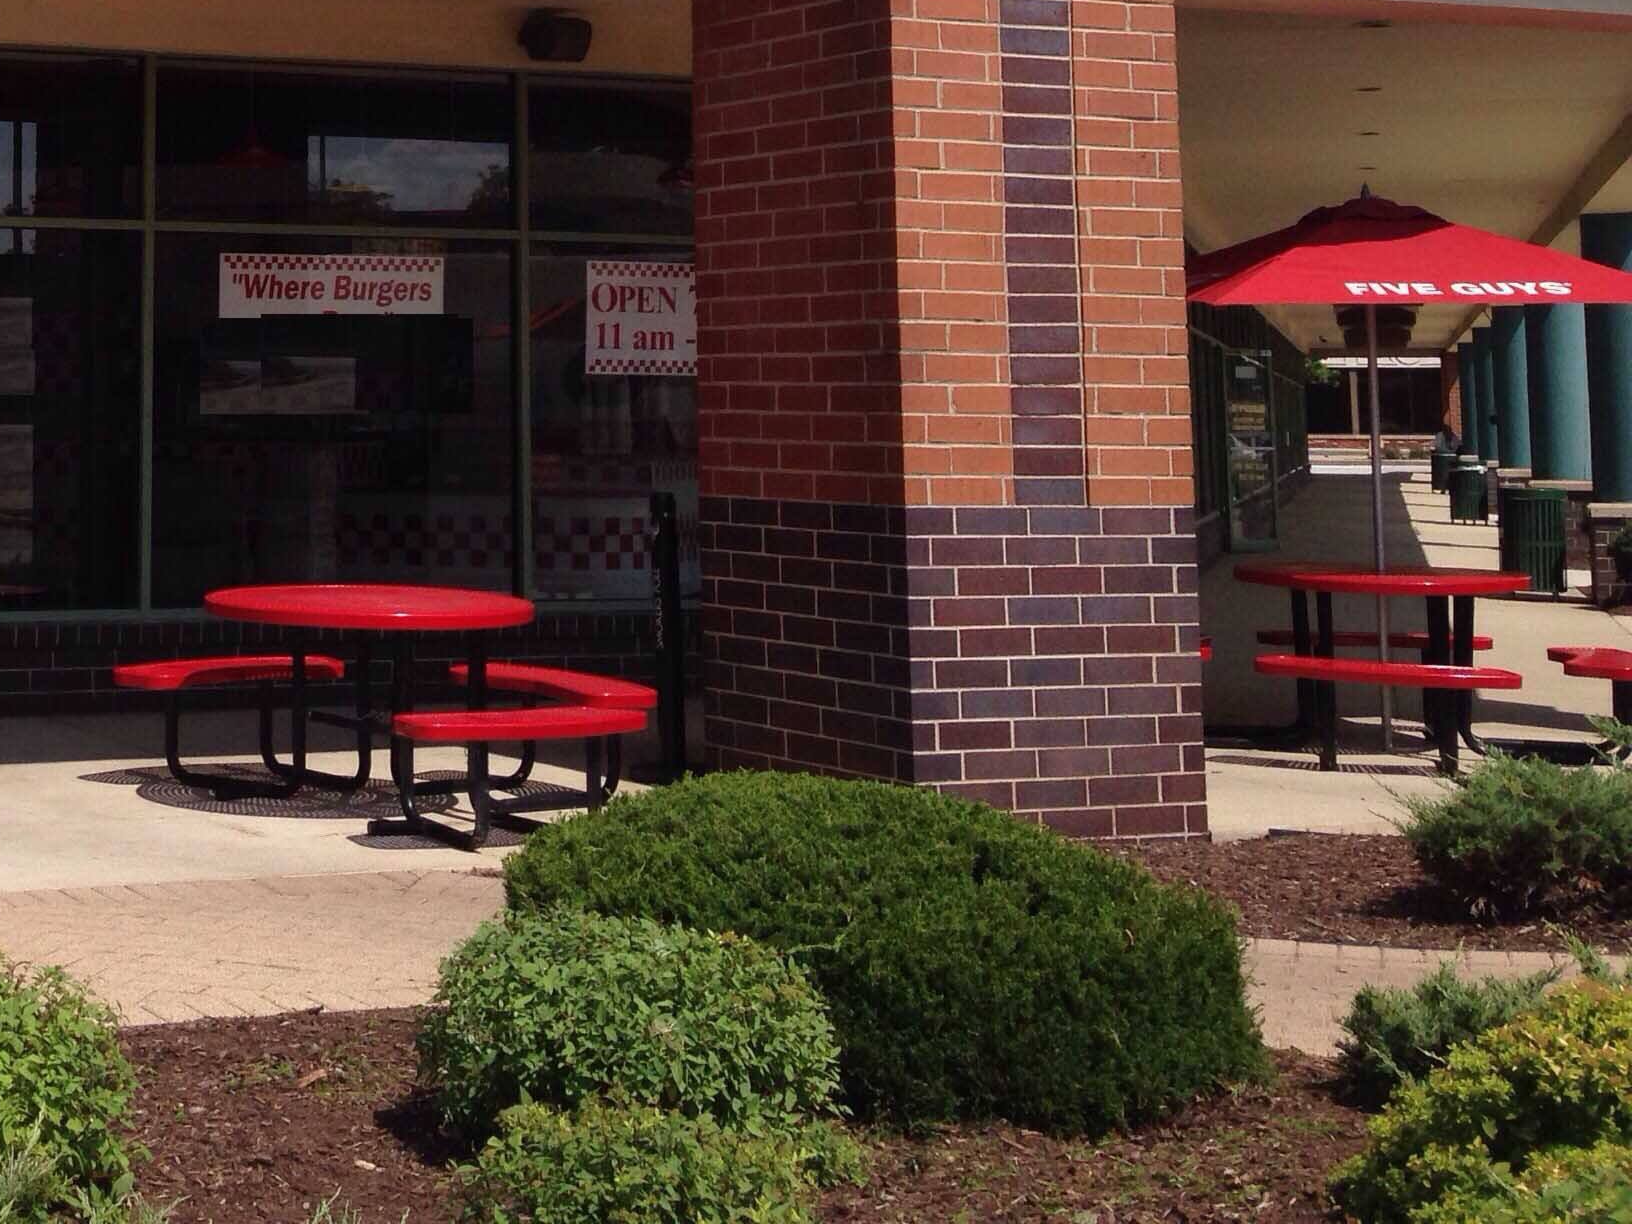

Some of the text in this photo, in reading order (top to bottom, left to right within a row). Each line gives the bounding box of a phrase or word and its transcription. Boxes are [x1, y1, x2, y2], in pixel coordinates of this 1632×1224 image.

[334, 275, 432, 307] Burgers
[592, 282, 679, 313] OPEN
[1344, 281, 1573, 296] FIVE GUYS
[597, 323, 620, 349] 11
[633, 330, 674, 350] am
